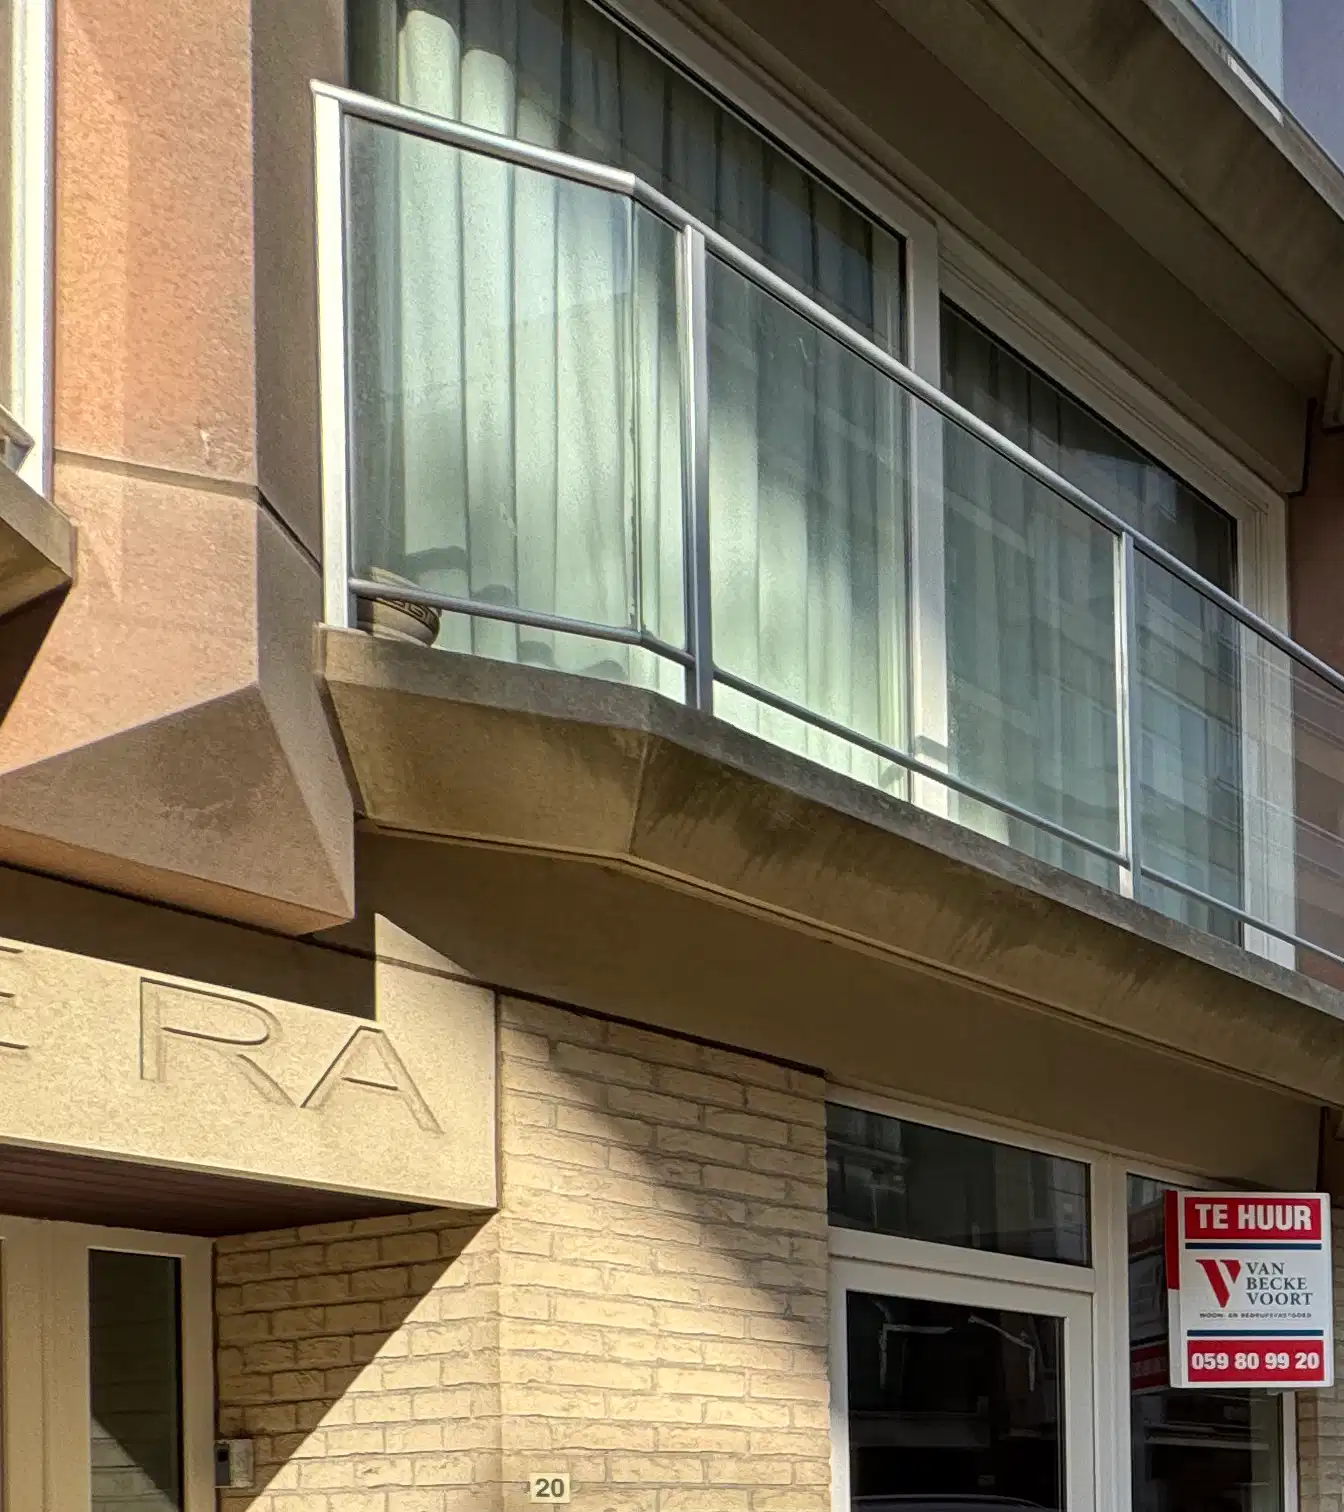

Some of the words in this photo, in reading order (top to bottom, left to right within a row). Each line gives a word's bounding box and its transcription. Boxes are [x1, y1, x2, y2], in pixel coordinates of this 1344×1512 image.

[1194, 1203, 1229, 1230] TE
[1237, 1204, 1312, 1231] HUUR
[1245, 1262, 1285, 1275] VAN
[1246, 1277, 1308, 1291] BECKE
[1246, 1292, 1314, 1306] VOORT
[1191, 1352, 1229, 1370] 059
[1234, 1352, 1260, 1370] 80
[1264, 1352, 1290, 1370] 99
[1294, 1352, 1320, 1370] 20
[535, 1477, 566, 1498] 20
